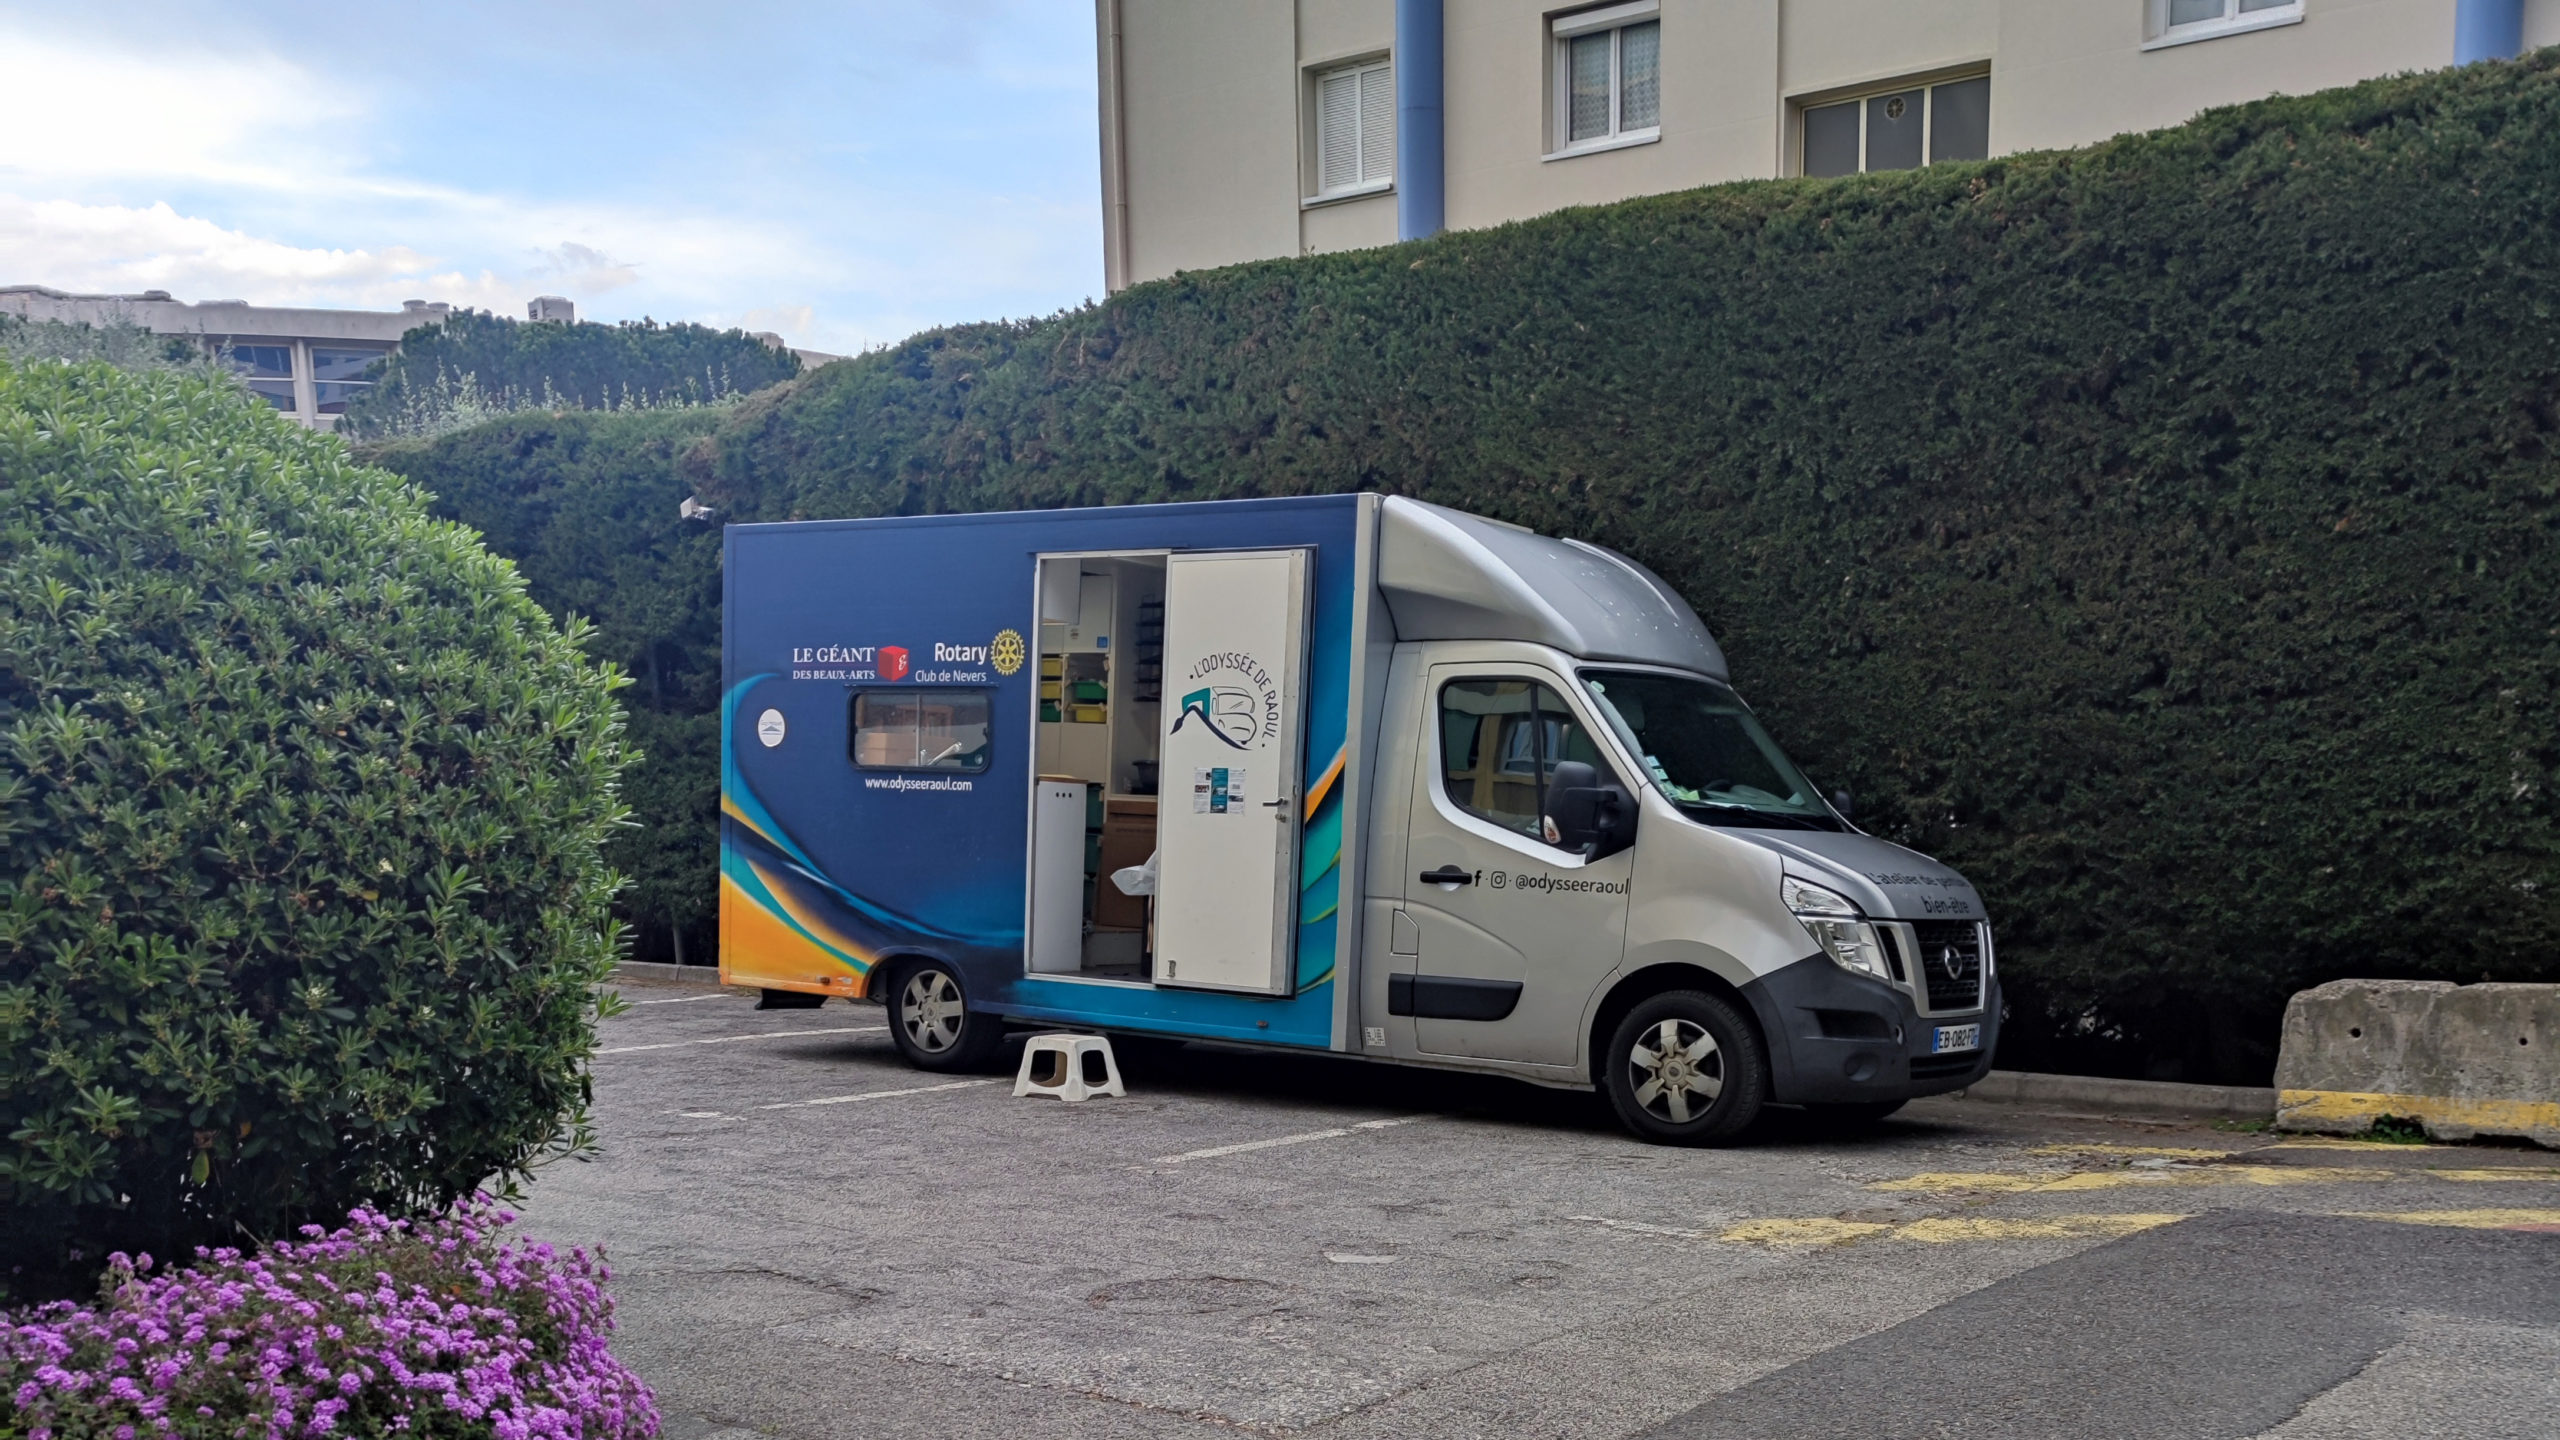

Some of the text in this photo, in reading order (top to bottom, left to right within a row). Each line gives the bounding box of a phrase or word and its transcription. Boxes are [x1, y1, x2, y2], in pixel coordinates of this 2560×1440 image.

[793, 644, 875, 663] LE GÉANT
[934, 642, 987, 665] Rotary
[793, 669, 875, 680] DES BEAUX-ARTS
[915, 670, 987, 683] Club de Nevers
[1194, 652, 1279, 739] L'ODYSSÉE DE RAOUL
[865, 776, 972, 792] www.odysseeraoul.com
[1516, 873, 1629, 895] @odysseeraoul
